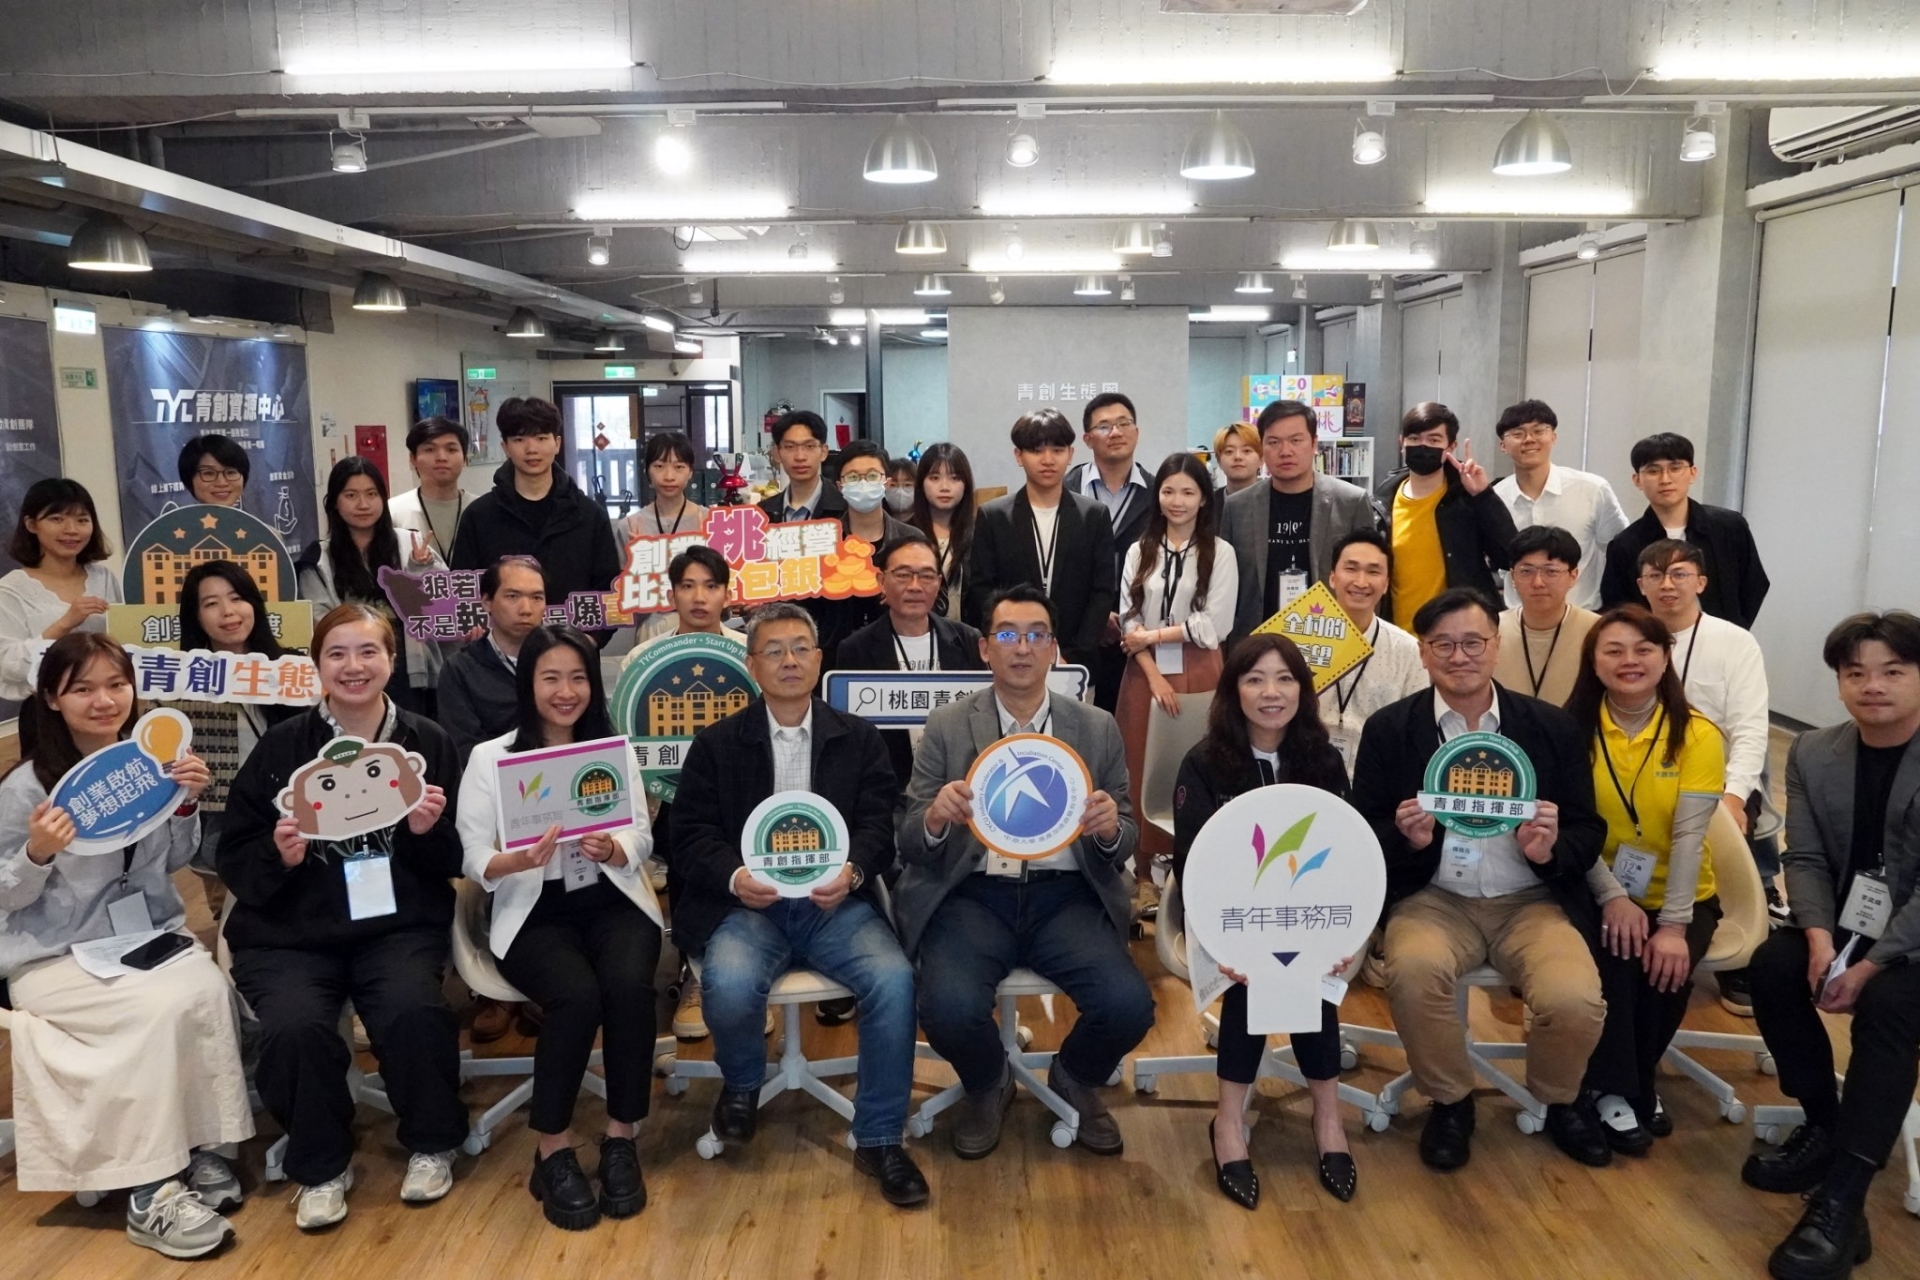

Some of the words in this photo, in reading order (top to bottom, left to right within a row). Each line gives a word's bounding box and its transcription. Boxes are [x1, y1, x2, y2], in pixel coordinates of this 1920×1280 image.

[1286, 377, 1307, 390] 20
[195, 392, 285, 422] 青創資源中心
[423, 572, 483, 600] 狼若
[1282, 611, 1347, 641] 全村的
[639, 637, 697, 666] TYCommander
[705, 637, 726, 648] Start
[726, 643, 738, 653] Up
[125, 652, 327, 699] 青創生態
[980, 763, 999, 793] Accelerator
[1016, 750, 1049, 760] Incubation
[1048, 756, 1065, 771] Center
[68, 757, 149, 816] 創業啟航
[76, 771, 159, 831] 夢想起飛
[1433, 796, 1525, 816] 青創指揮部
[763, 852, 830, 868] 青創指揮部
[1622, 861, 1636, 874] 12
[1220, 904, 1353, 933] 青年事務局
[149, 1215, 174, 1238] N
